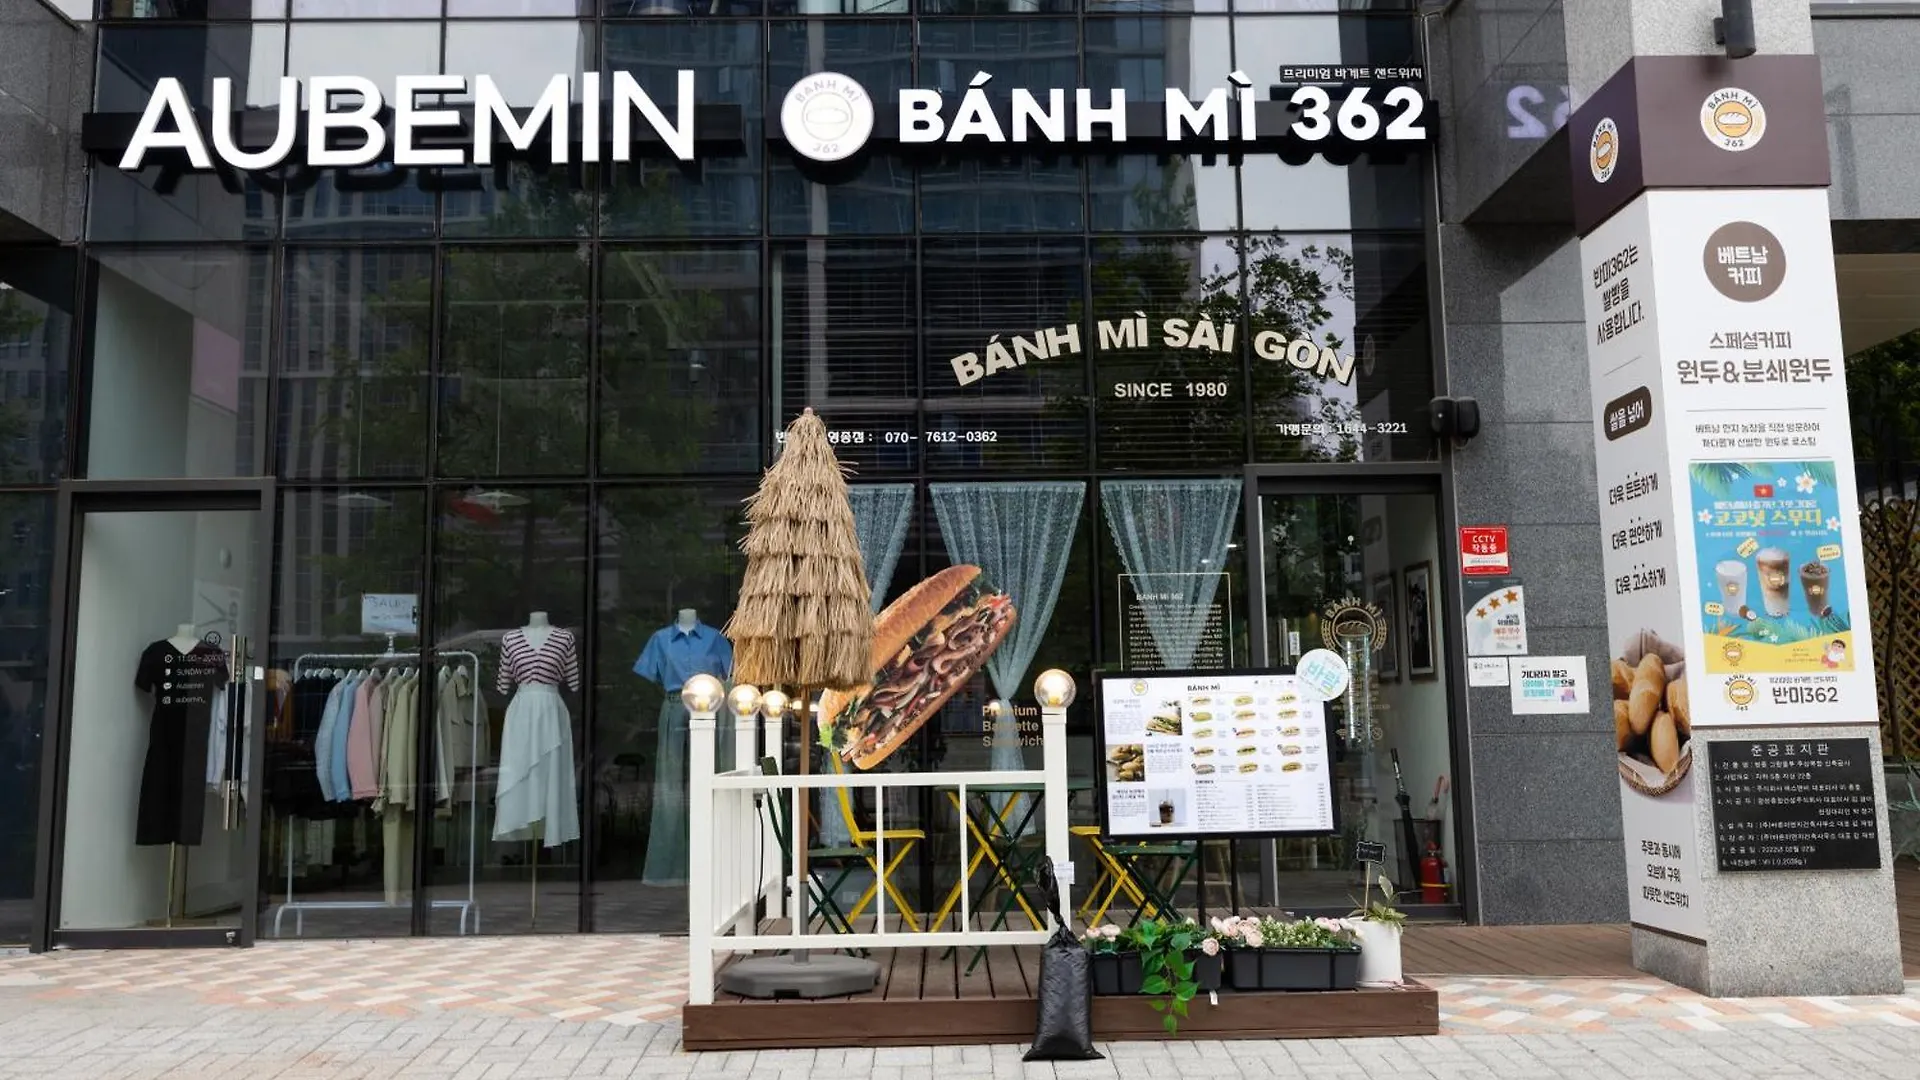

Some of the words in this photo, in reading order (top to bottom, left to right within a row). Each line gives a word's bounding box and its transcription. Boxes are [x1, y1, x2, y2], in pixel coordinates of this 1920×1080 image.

[899, 70, 1126, 144] BÁNH
[1165, 69, 1257, 142] MÌ
[1290, 86, 1427, 142] 362
[118, 68, 696, 171] AUBEMIN
[812, 142, 840, 154] 362
[1723, 138, 1745, 148] 362
[1717, 245, 1768, 264] 베트남
[1593, 244, 1639, 289] 반미362는
[1728, 266, 1762, 285] 커피
[1602, 276, 1630, 313] 쌀빵을
[1597, 299, 1645, 346] 사용합니다.
[949, 319, 1081, 387] BÁNH
[1097, 310, 1150, 353] MÌ
[1162, 312, 1236, 353] SÀI
[1253, 328, 1356, 386] GÒN
[1709, 331, 1792, 350] 스페셜커피
[1676, 358, 1833, 385] 원두&분쇄원두
[1113, 382, 1174, 399] SINCE
[1184, 382, 1229, 398] 1980
[925, 431, 998, 443] 7612-0362
[1336, 422, 1408, 434] 1644-3221
[1608, 484, 1624, 506] 더욱
[1625, 471, 1660, 501] 든든하게
[1770, 508, 1822, 528] 스무디
[1472, 535, 1497, 544] CCTV
[1611, 529, 1628, 551] 더욱
[1615, 574, 1632, 596] 더욱
[1772, 686, 1839, 704] 반미362
